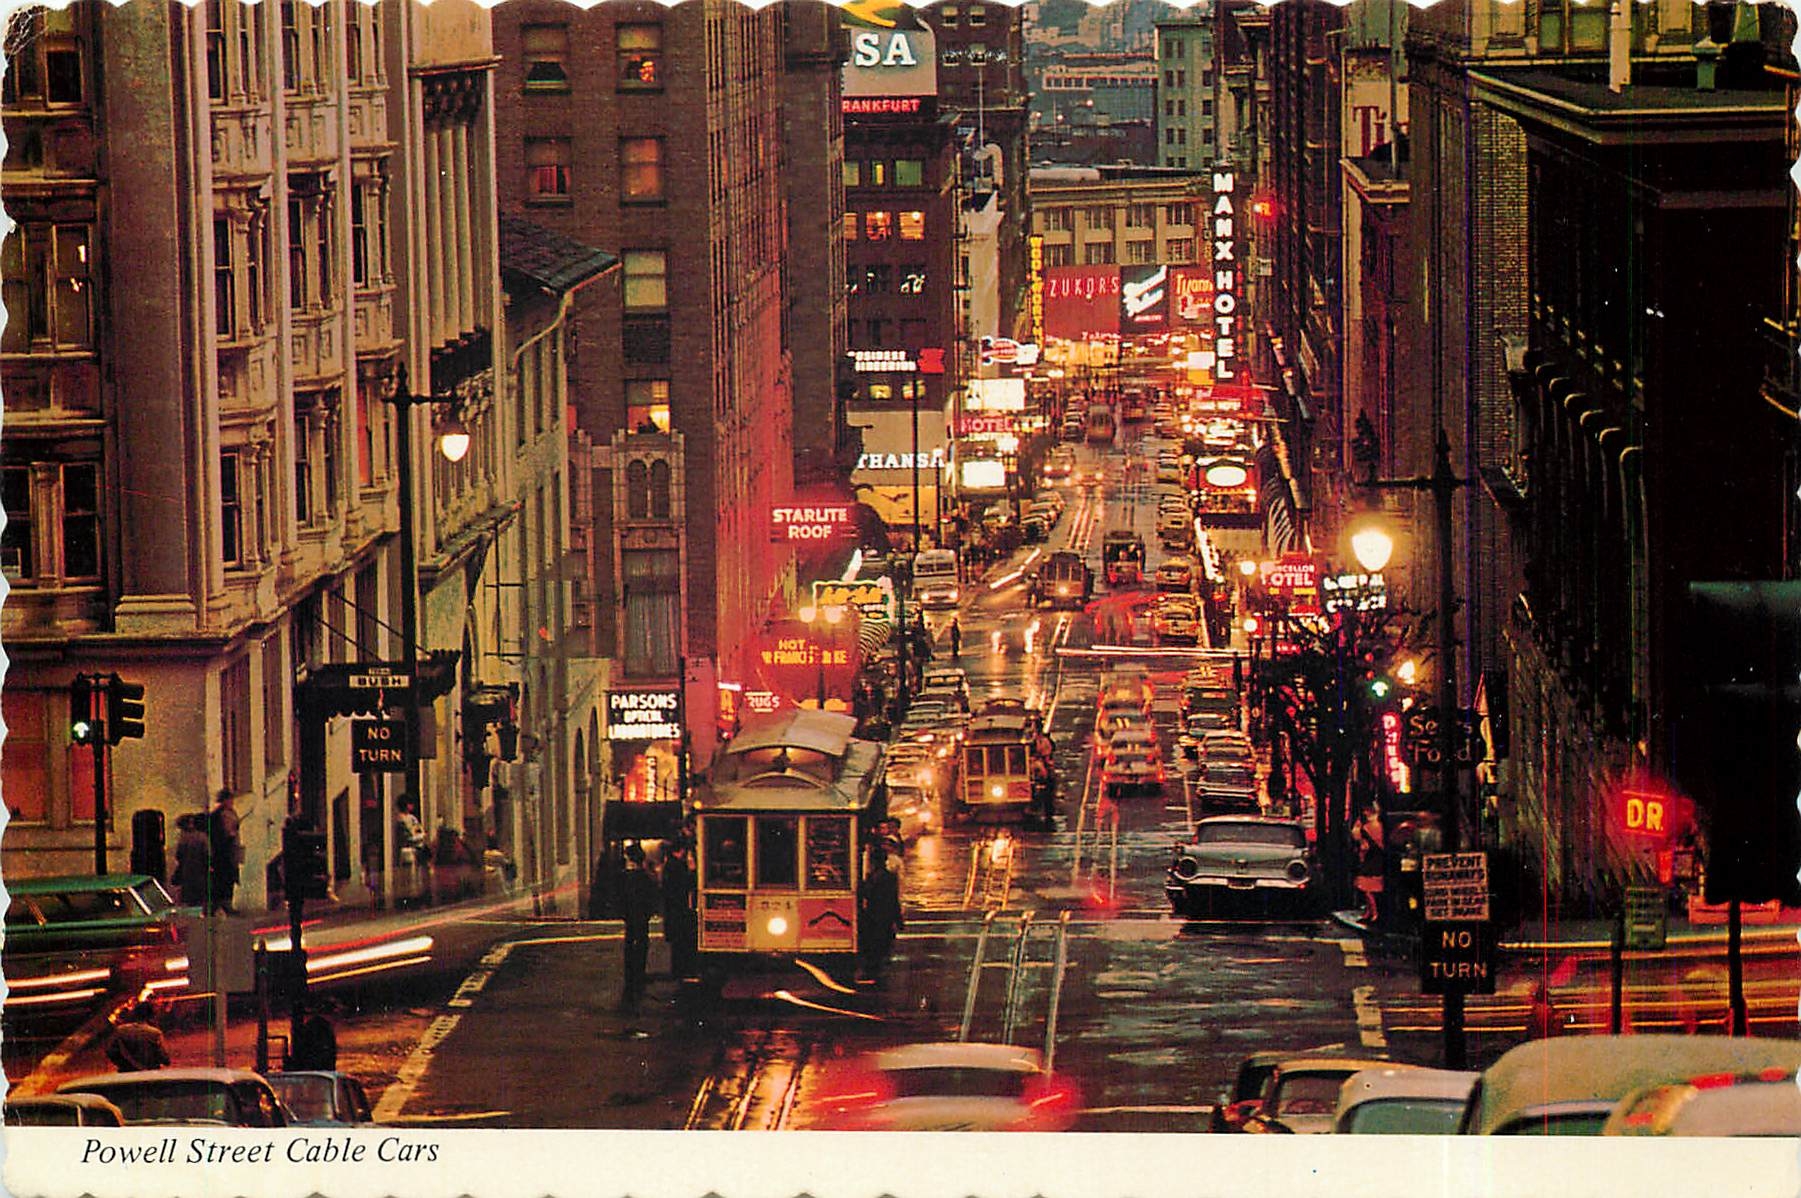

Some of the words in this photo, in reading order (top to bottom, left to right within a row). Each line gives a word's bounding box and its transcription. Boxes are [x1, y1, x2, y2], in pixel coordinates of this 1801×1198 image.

[1213, 173, 1234, 260] MANX
[1214, 270, 1235, 378] HOTEL
[960, 417, 1014, 433] HOTEL
[772, 508, 847, 522] STARLITE
[788, 524, 832, 539] ROOF
[611, 693, 677, 709] PARSONS
[367, 727, 391, 740] NO
[359, 749, 401, 762] TURN
[1442, 931, 1471, 948] NO
[1430, 961, 1487, 977] TURN
